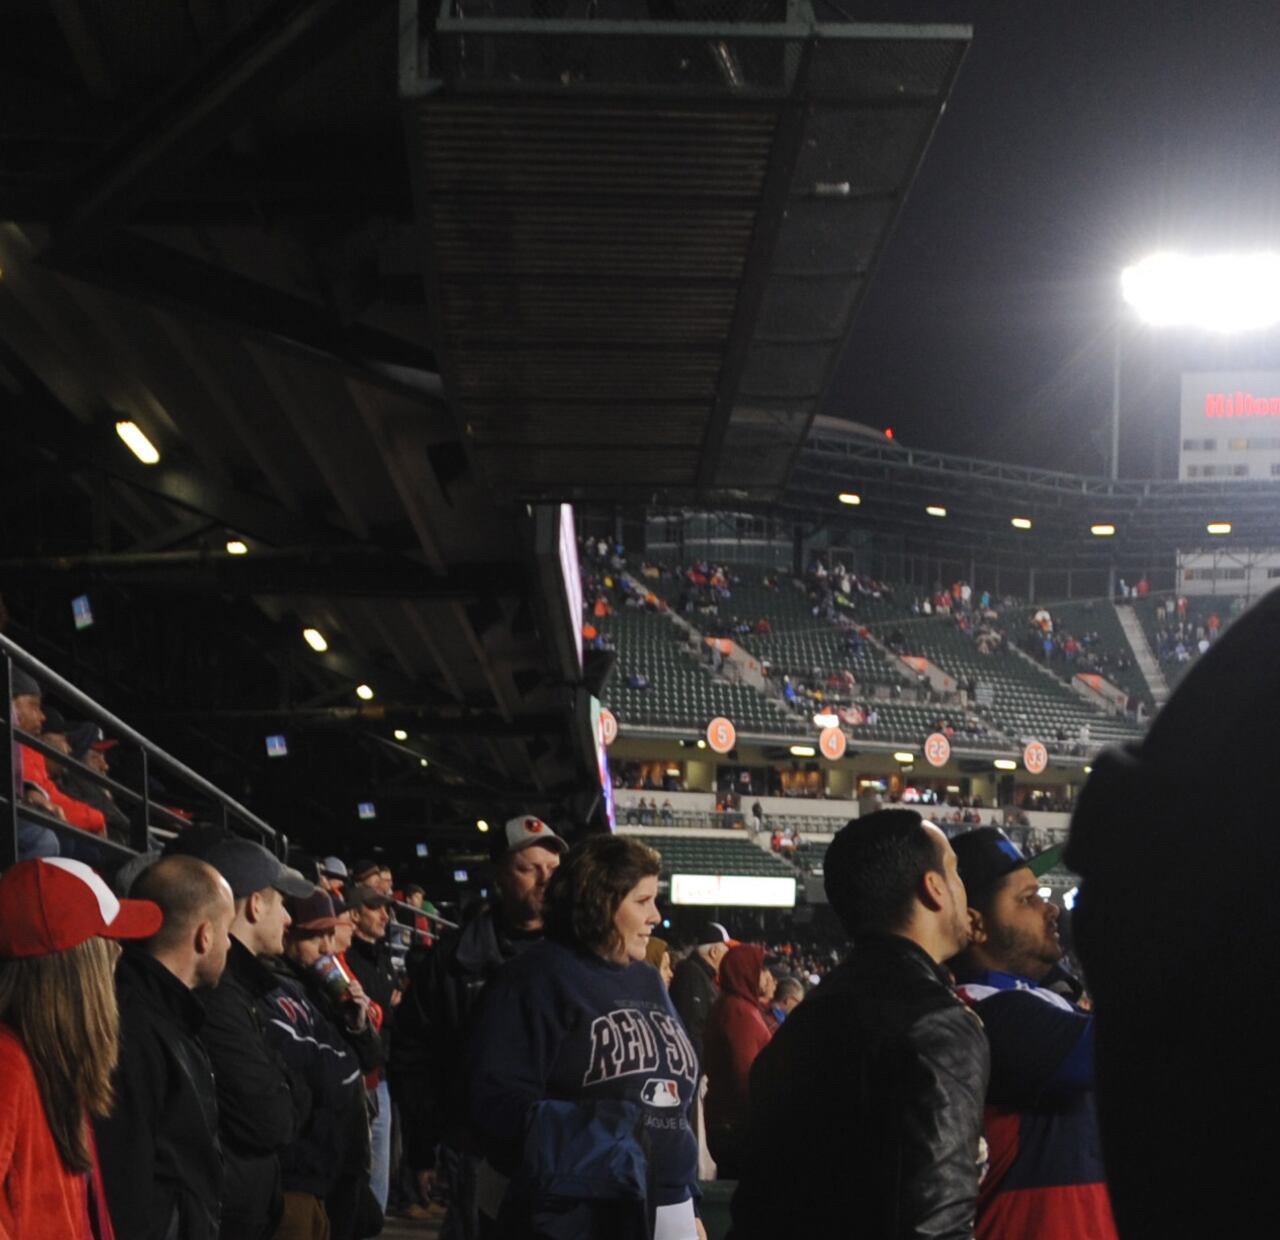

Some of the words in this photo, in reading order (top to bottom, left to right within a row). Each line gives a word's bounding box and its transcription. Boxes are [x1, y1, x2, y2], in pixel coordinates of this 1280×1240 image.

[717, 725, 728, 744] 5
[828, 733, 838, 752] 4
[929, 740, 945, 758] 22
[1029, 748, 1045, 766] 33
[583, 1008, 659, 1087] RED
